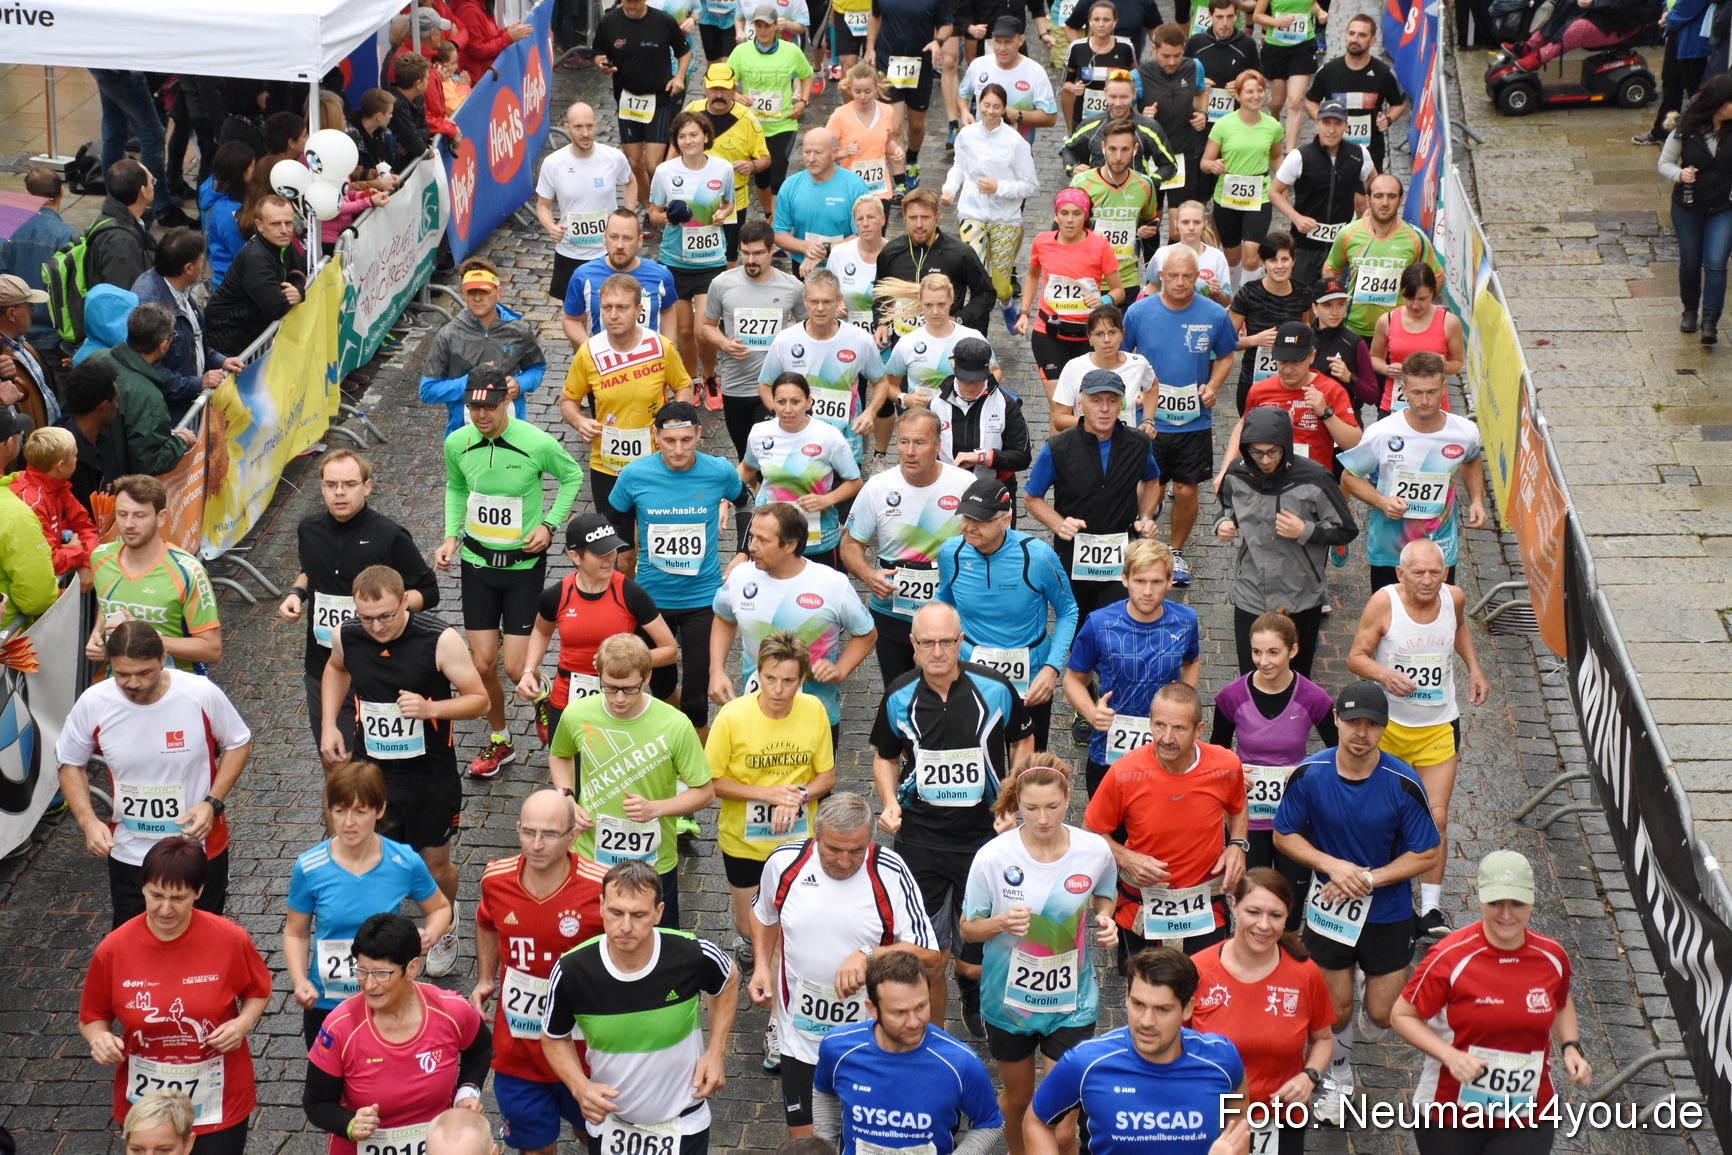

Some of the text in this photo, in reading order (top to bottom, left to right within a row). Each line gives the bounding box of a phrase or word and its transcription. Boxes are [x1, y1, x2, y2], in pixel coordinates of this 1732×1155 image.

[0, 2, 54, 26] rive
[896, 65, 914, 76] 114
[627, 97, 649, 110] 177
[758, 98, 772, 111] 26
[489, 103, 523, 166] Hervis
[1231, 183, 1255, 197] 253
[572, 219, 605, 235] 3050
[1312, 225, 1342, 240] 226
[687, 233, 719, 250] 2863
[692, 250, 716, 258] Elisabeth
[1053, 284, 1081, 299] 212
[1361, 276, 1397, 292] 2844
[739, 319, 779, 334] 2277
[600, 363, 665, 389] MAX BÖGL
[1157, 394, 1196, 411] 2065
[1167, 413, 1184, 421] Klaus
[611, 439, 642, 456] 290
[1396, 482, 1444, 501] 2587
[478, 507, 512, 525] 608
[647, 506, 707, 516] www.hasit.de
[654, 536, 702, 555] 2489
[1080, 545, 1122, 564] 2021
[665, 559, 691, 568] Hubert
[1087, 568, 1113, 576] Werner
[366, 716, 416, 738] 2647
[376, 742, 409, 752] Thomas
[752, 752, 808, 769] FRANCESCO
[923, 762, 979, 785] 2036
[935, 789, 967, 800] Johann
[122, 796, 180, 818] 2703
[137, 822, 166, 832] Marco
[601, 829, 655, 852] 2297
[801, 880, 819, 888] adidas
[1003, 888, 1024, 897] PARTL
[1150, 893, 1206, 917] 2214
[1167, 920, 1192, 931] Peter
[1313, 912, 1344, 934] Thomas
[1015, 966, 1071, 992] 2203
[1024, 994, 1058, 1005] Carolin
[1200, 996, 1219, 1006] Spitz
[801, 993, 860, 1023] 3062
[1472, 1064, 1536, 1093] 2652
[852, 1104, 932, 1130] SYSCAD
[1115, 1110, 1204, 1130] SYSCAD
[610, 1128, 674, 1155] 3068
[1112, 1132, 1207, 1142] www.metallbau-cad.de
